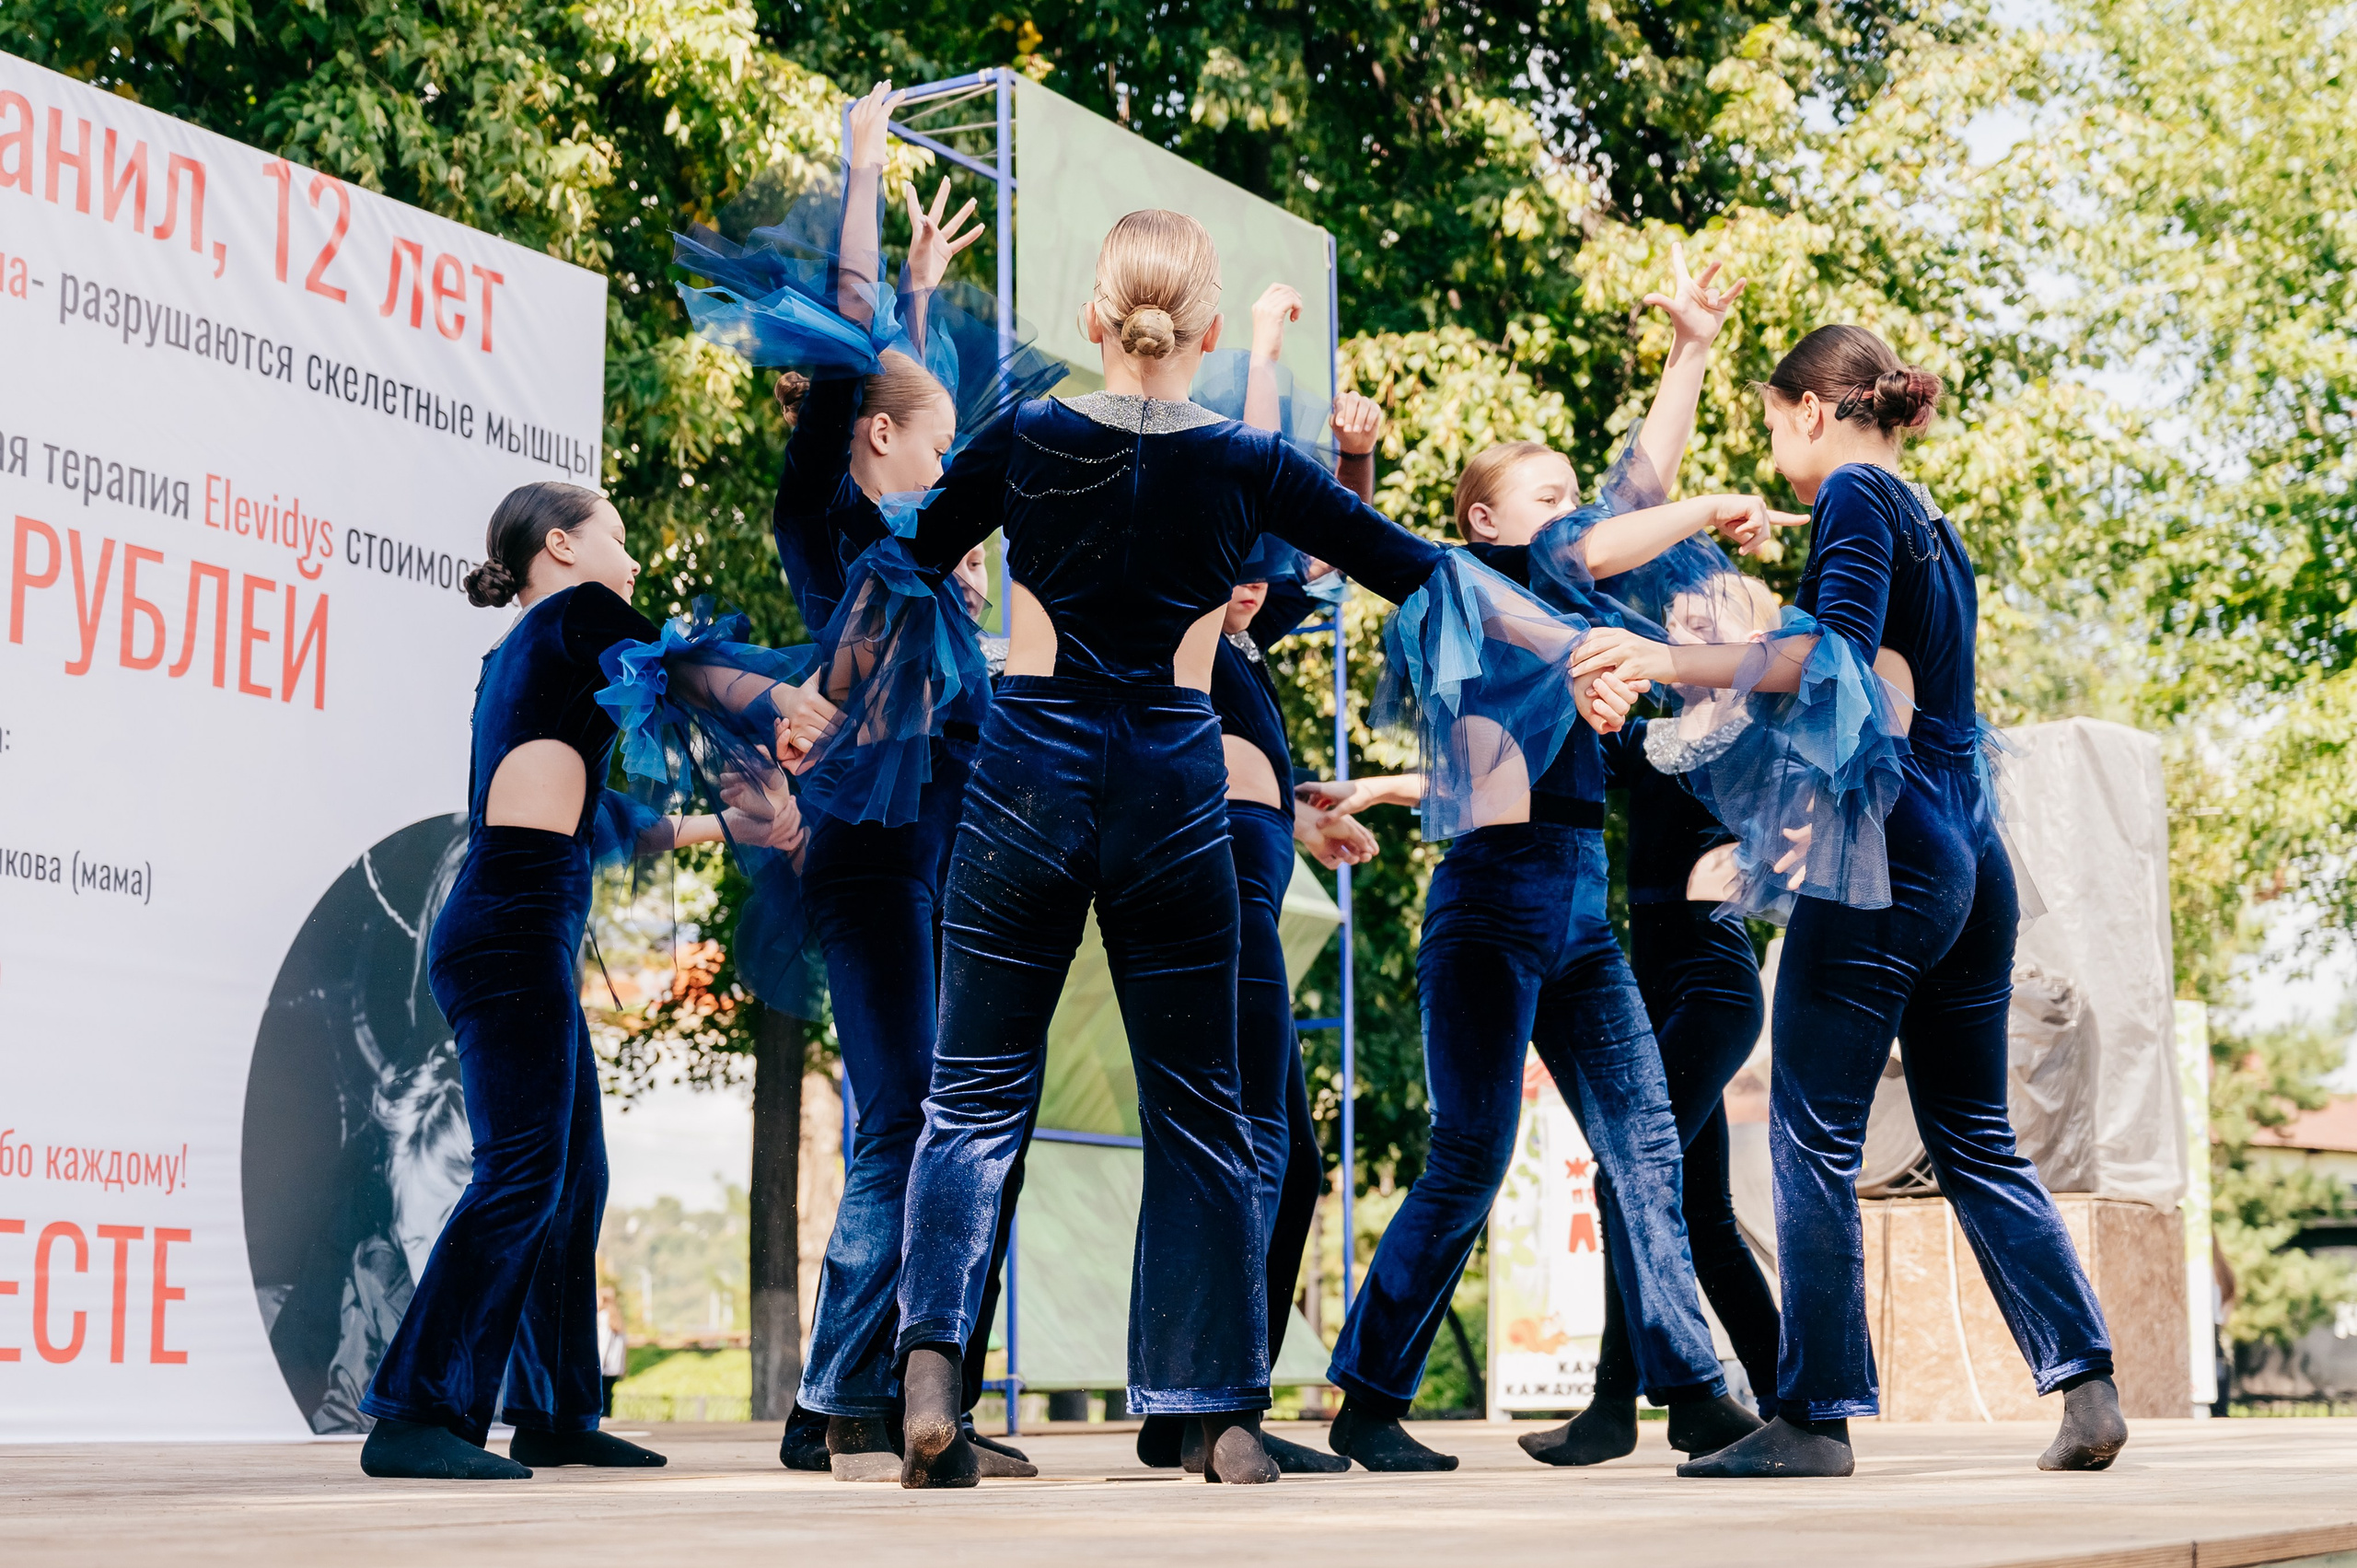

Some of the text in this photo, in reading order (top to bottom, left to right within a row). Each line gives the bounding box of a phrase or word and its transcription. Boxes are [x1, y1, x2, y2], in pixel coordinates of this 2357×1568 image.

[262, 157, 350, 304] 12
[378, 236, 505, 354] лет
[60, 272, 294, 383] разрушаются
[306, 353, 475, 439] скелетные
[485, 411, 594, 479] мышцы
[43, 442, 190, 520] терапия
[204, 472, 333, 561] Elevidys
[346, 528, 482, 594] стоимос
[9, 515, 330, 711] РУБЛЕЙ
[0, 848, 151, 905] кова (мама)
[46, 1143, 188, 1195] каждому!
